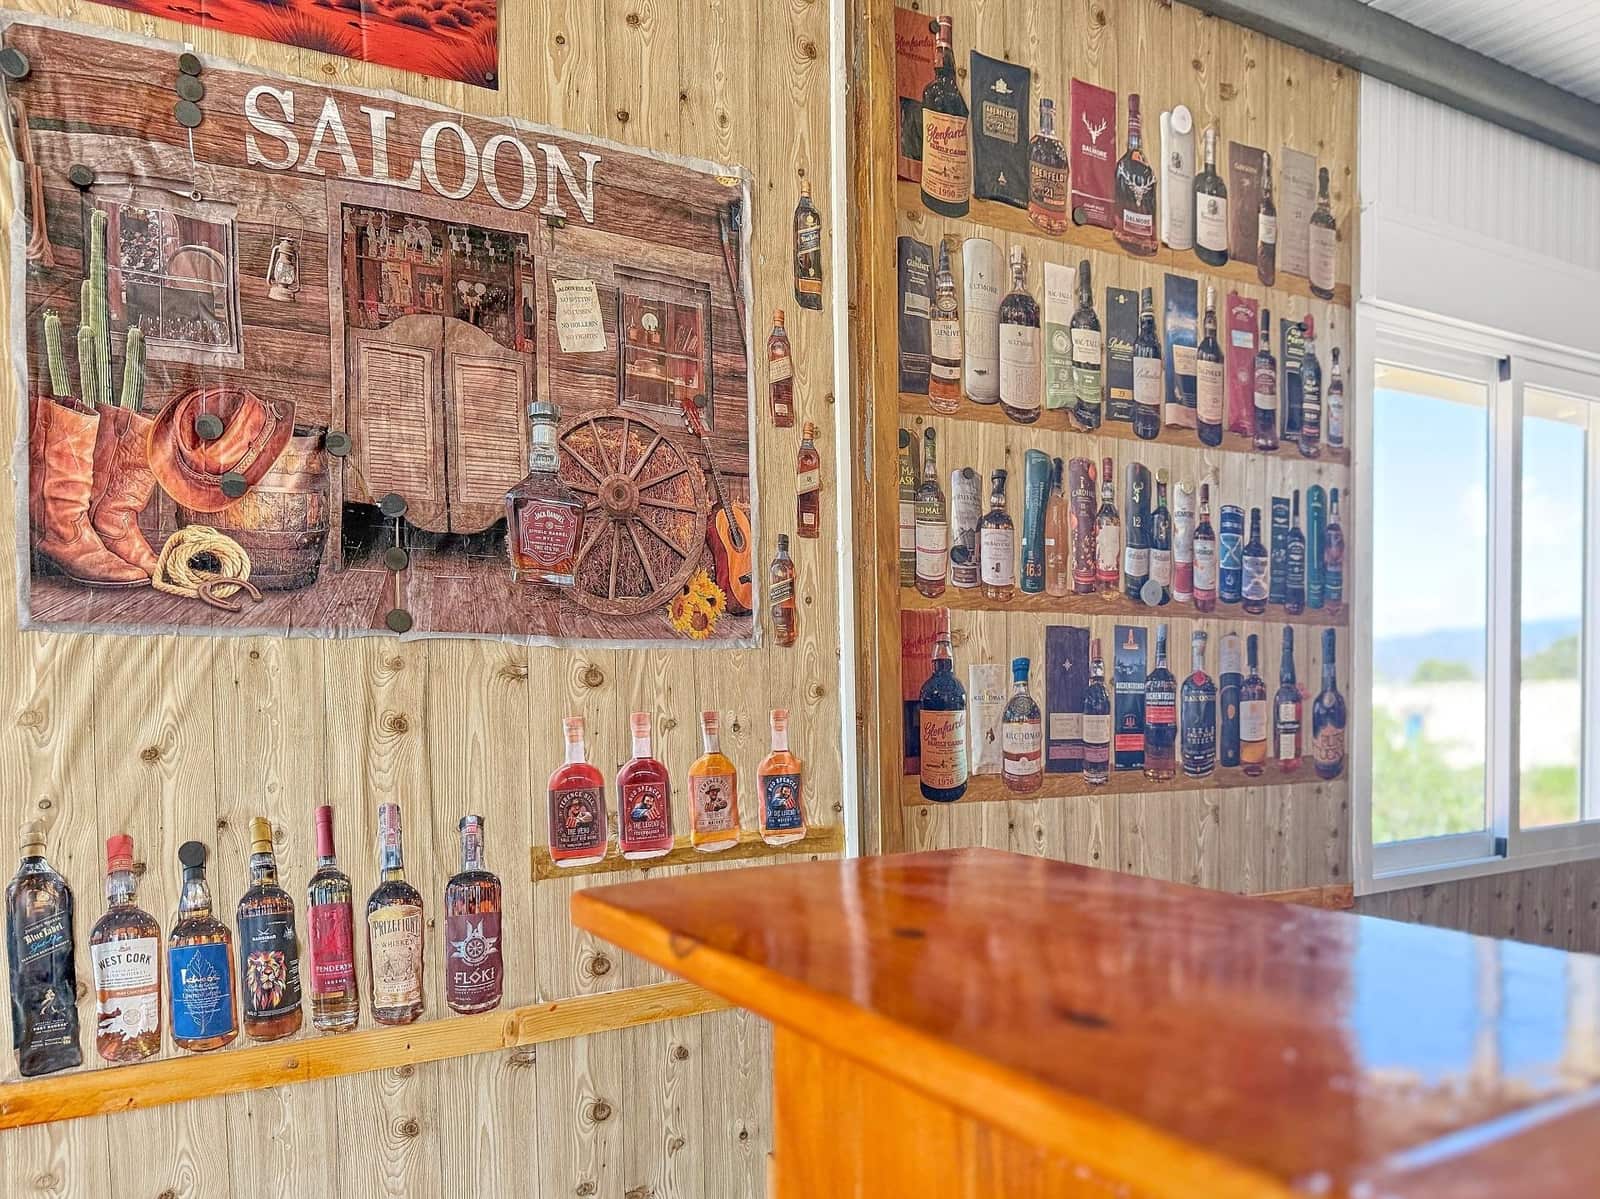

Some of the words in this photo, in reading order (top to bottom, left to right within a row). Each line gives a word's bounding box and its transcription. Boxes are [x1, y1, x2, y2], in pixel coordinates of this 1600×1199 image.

[244, 85, 602, 224] SALOON
[1132, 516, 1142, 527] 12
[23, 931, 44, 945] Blue
[98, 954, 123, 970] WEST
[126, 952, 152, 965] CORK
